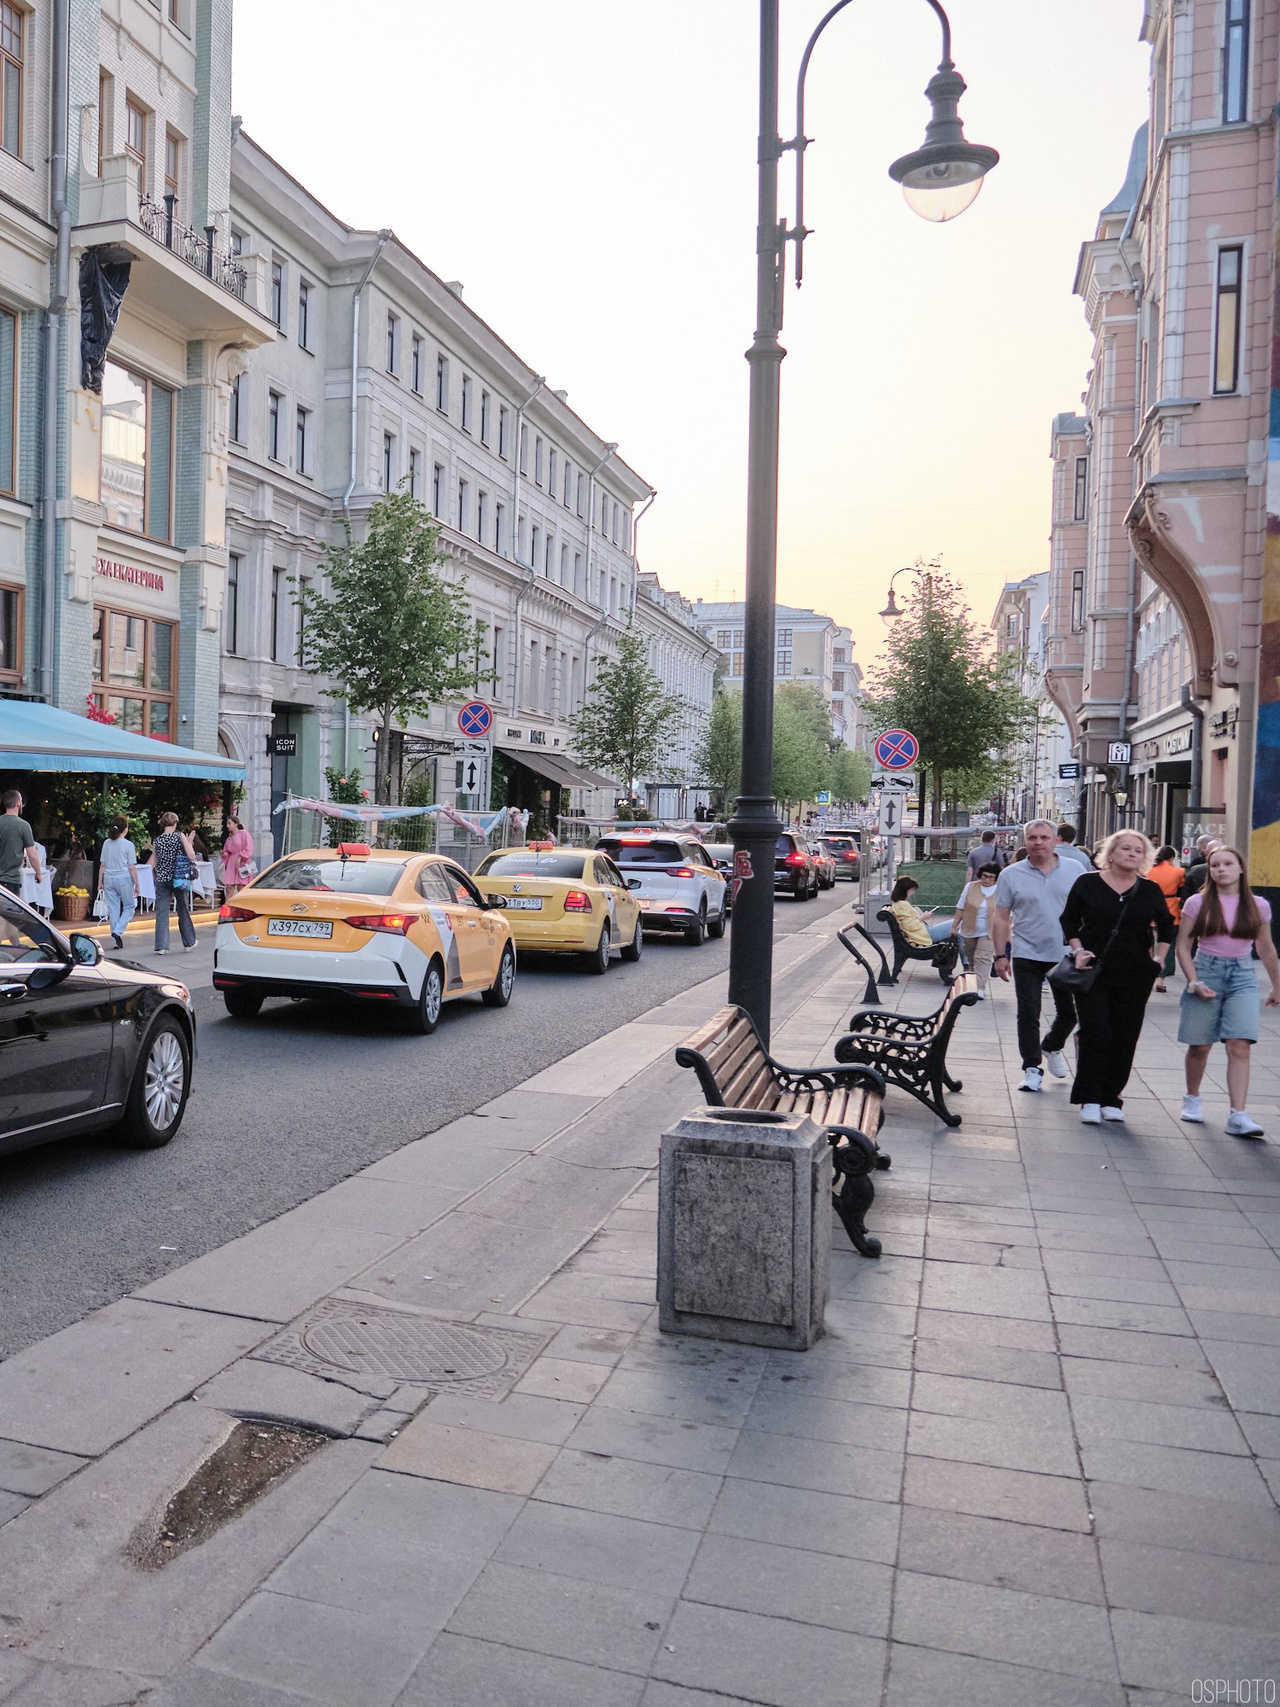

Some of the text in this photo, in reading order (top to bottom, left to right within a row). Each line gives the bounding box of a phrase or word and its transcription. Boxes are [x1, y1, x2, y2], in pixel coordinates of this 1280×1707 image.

[95, 556, 113, 578] ЕХА
[1183, 822, 1227, 835] FACE
[313, 922, 330, 932] 799
